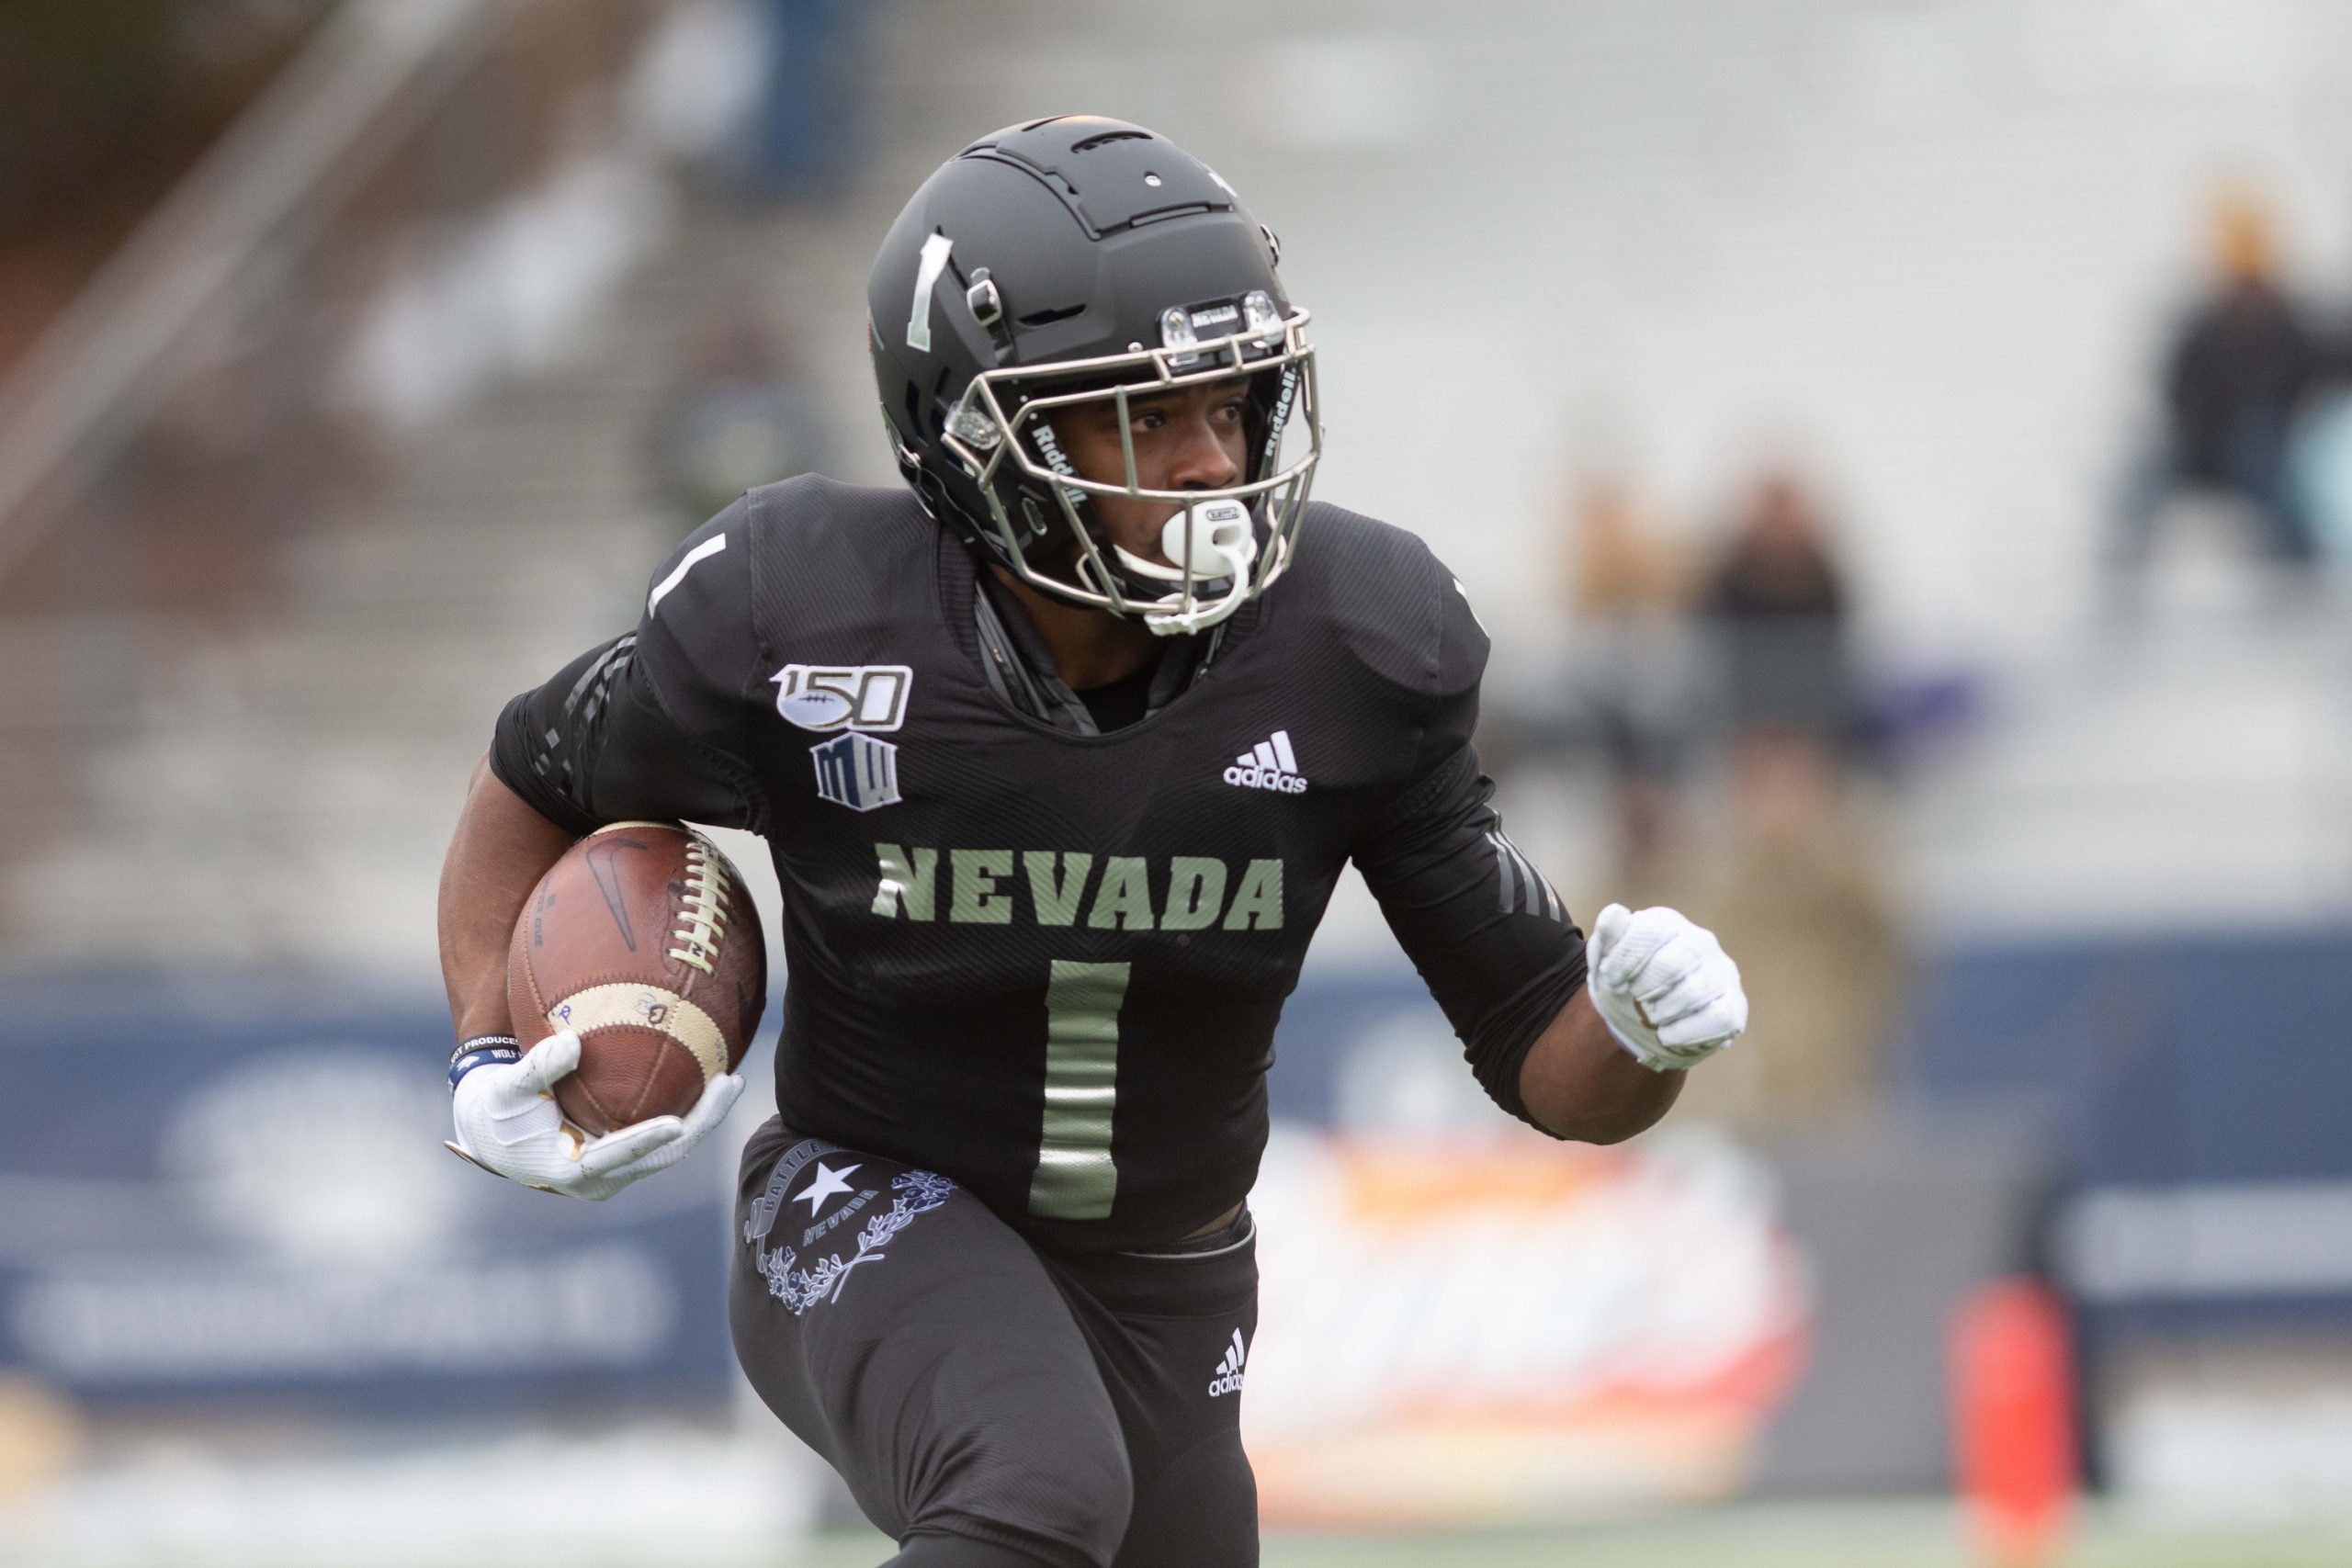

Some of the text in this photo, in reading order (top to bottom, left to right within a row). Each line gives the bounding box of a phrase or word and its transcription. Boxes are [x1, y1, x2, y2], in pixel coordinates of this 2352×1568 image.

[907, 233, 954, 353] 1
[1032, 424, 1088, 503] Riddll
[770, 664, 913, 732] 150
[1223, 764, 1308, 794] adidas
[871, 842, 1284, 931] NEVADA
[492, 1049, 516, 1059] WOLF
[1027, 959, 1132, 1220] 1
[764, 1142, 820, 1212] BATTLE
[803, 1190, 879, 1247] NEVADA
[1208, 1369, 1244, 1397] adida
